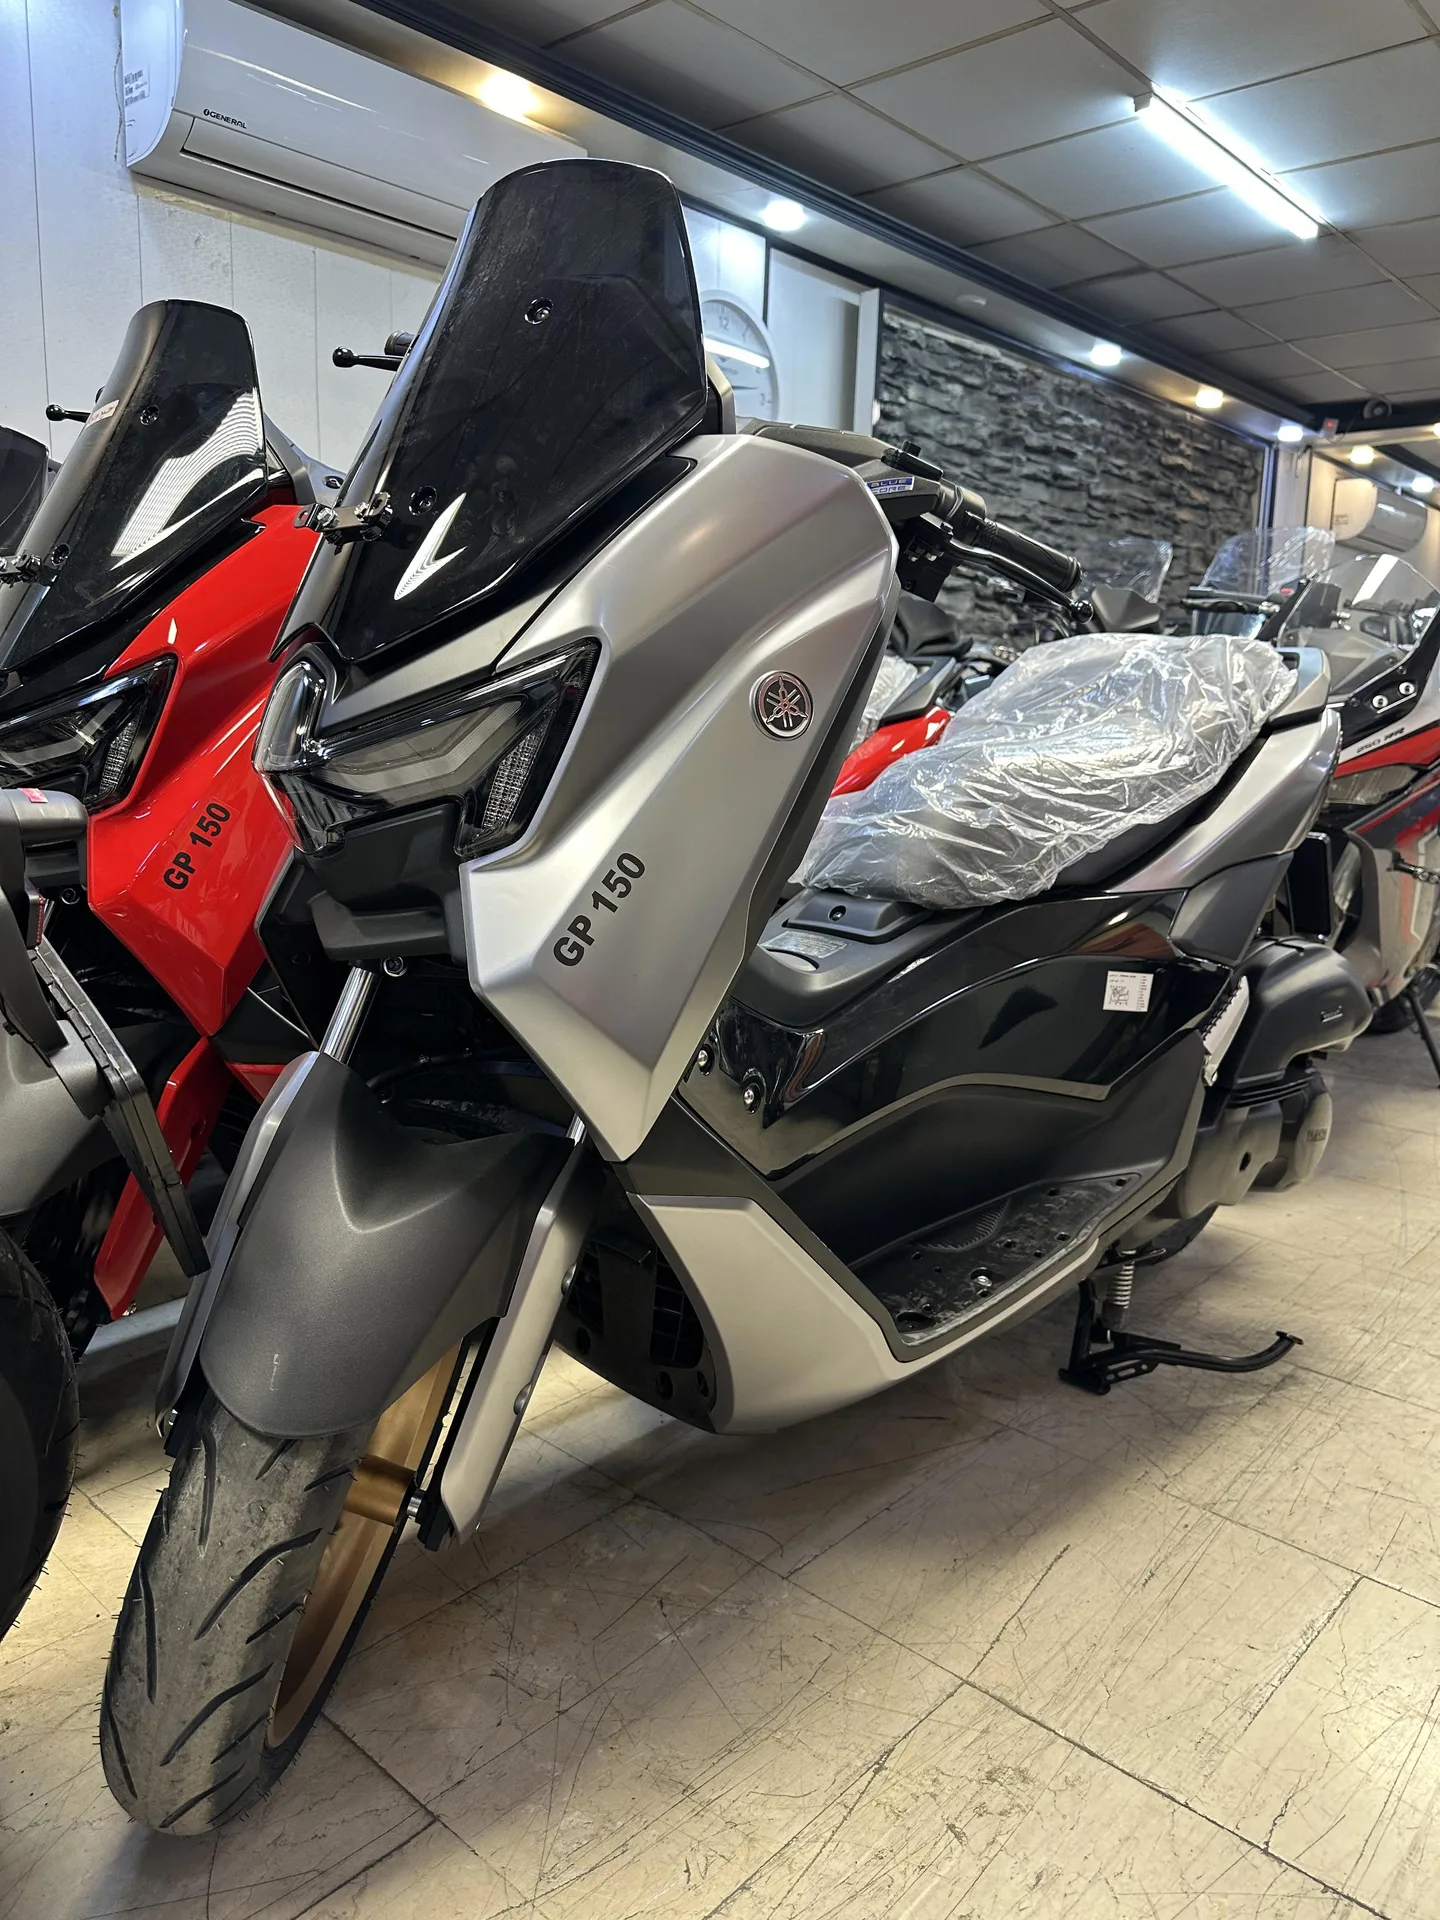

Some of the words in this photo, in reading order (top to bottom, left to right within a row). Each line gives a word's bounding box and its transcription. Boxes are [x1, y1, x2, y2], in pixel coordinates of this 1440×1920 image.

[163, 851, 196, 890] GP
[189, 802, 231, 848] 150
[553, 914, 596, 967] GP
[591, 852, 646, 914] 150
